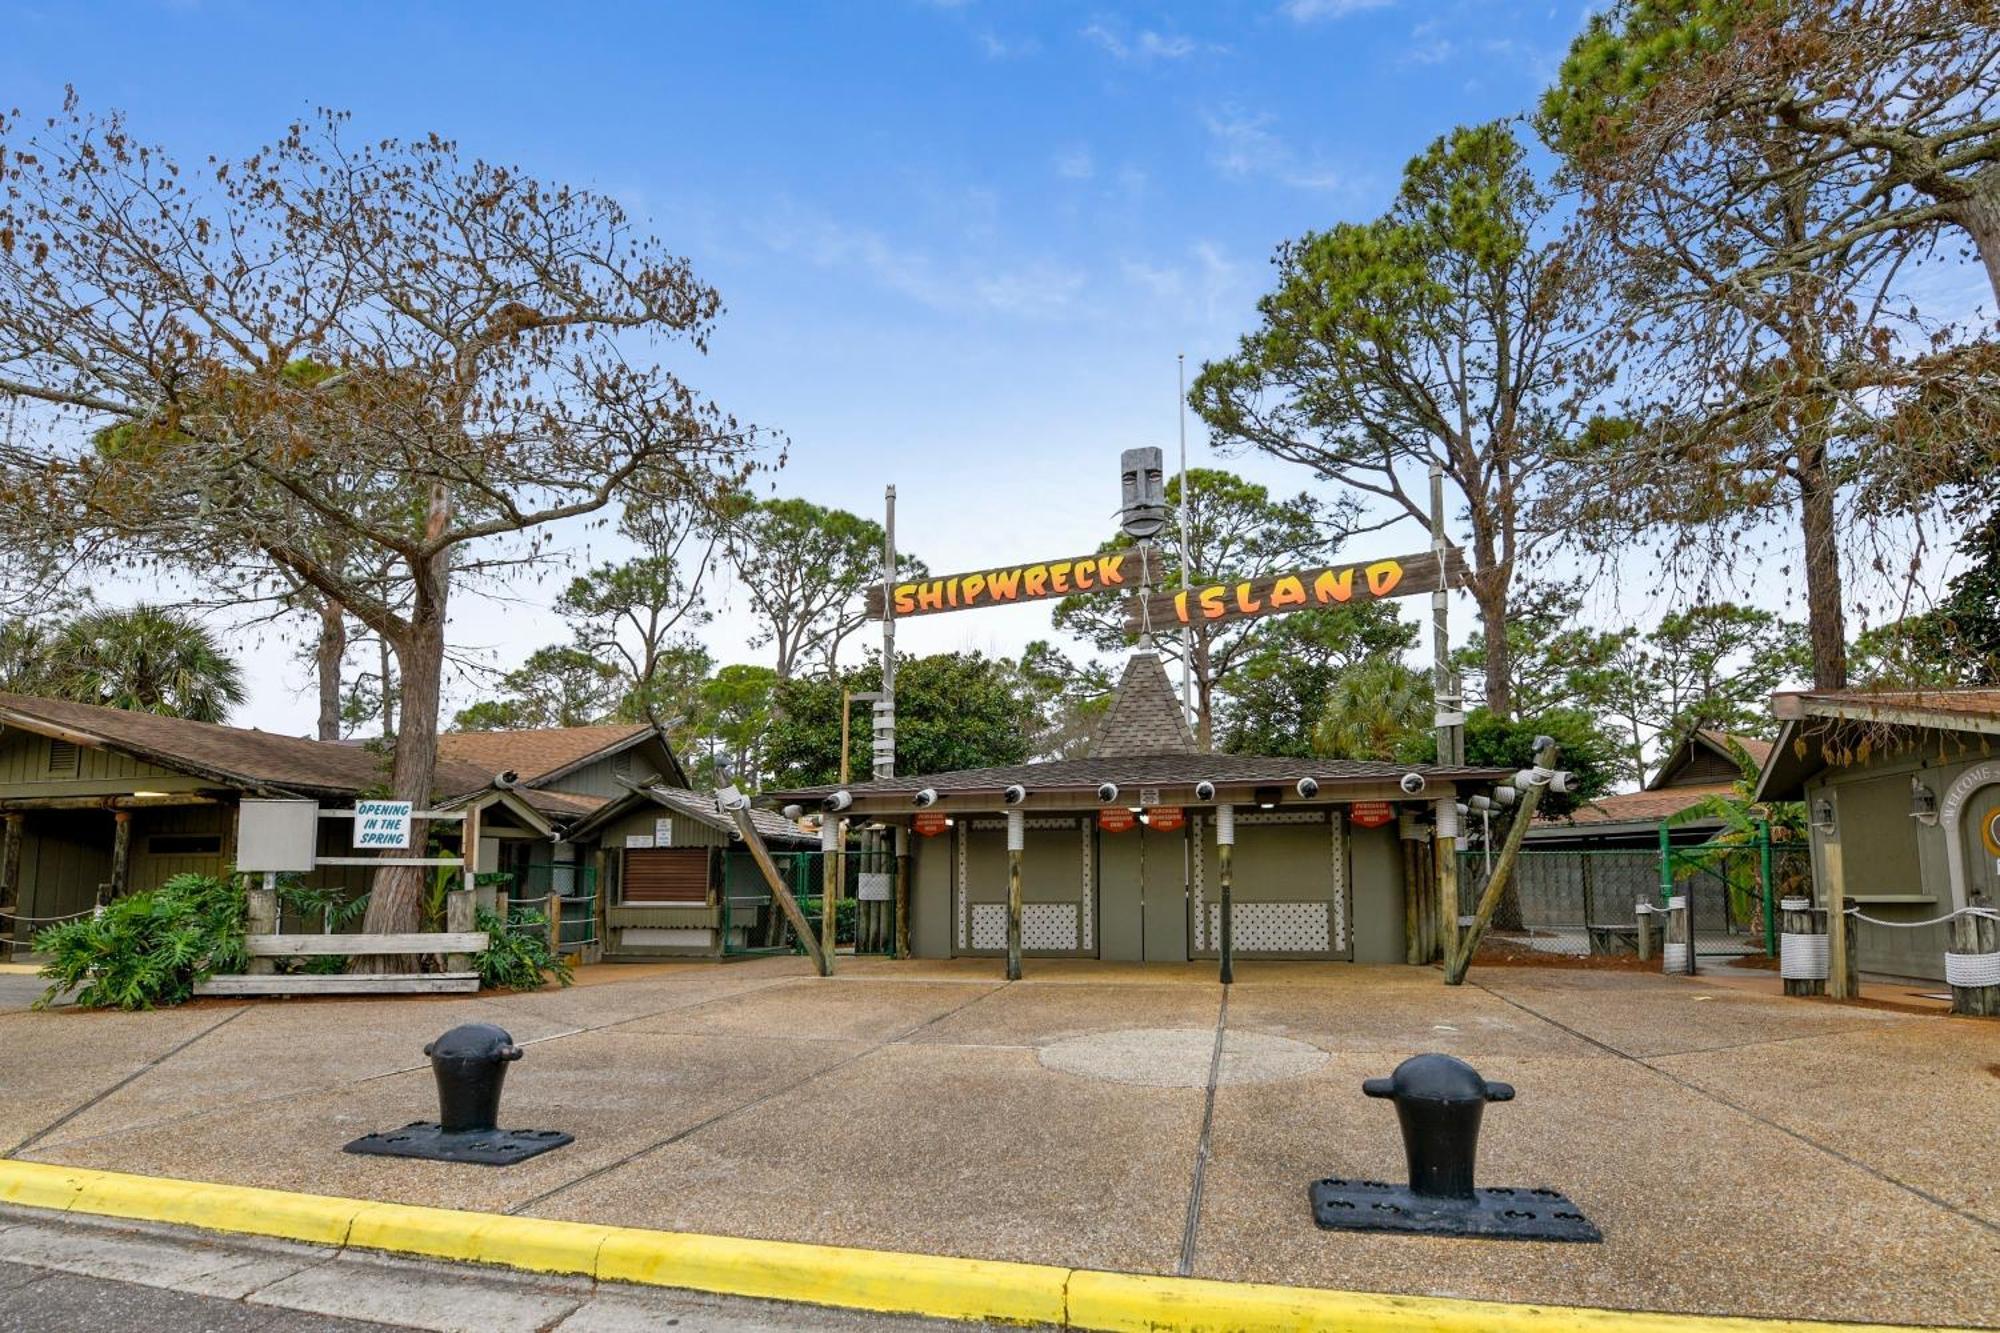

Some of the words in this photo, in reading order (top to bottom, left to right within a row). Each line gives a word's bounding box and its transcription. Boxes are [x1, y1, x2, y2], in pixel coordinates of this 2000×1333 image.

[894, 555, 1125, 614] SHIPWRECK
[1174, 560, 1403, 623] ISLAND
[1944, 767, 1990, 818] WELCOME
[358, 804, 409, 816] OPENING
[363, 819, 378, 830] IN
[380, 819, 402, 830] THE
[360, 833, 404, 844] SPRING
